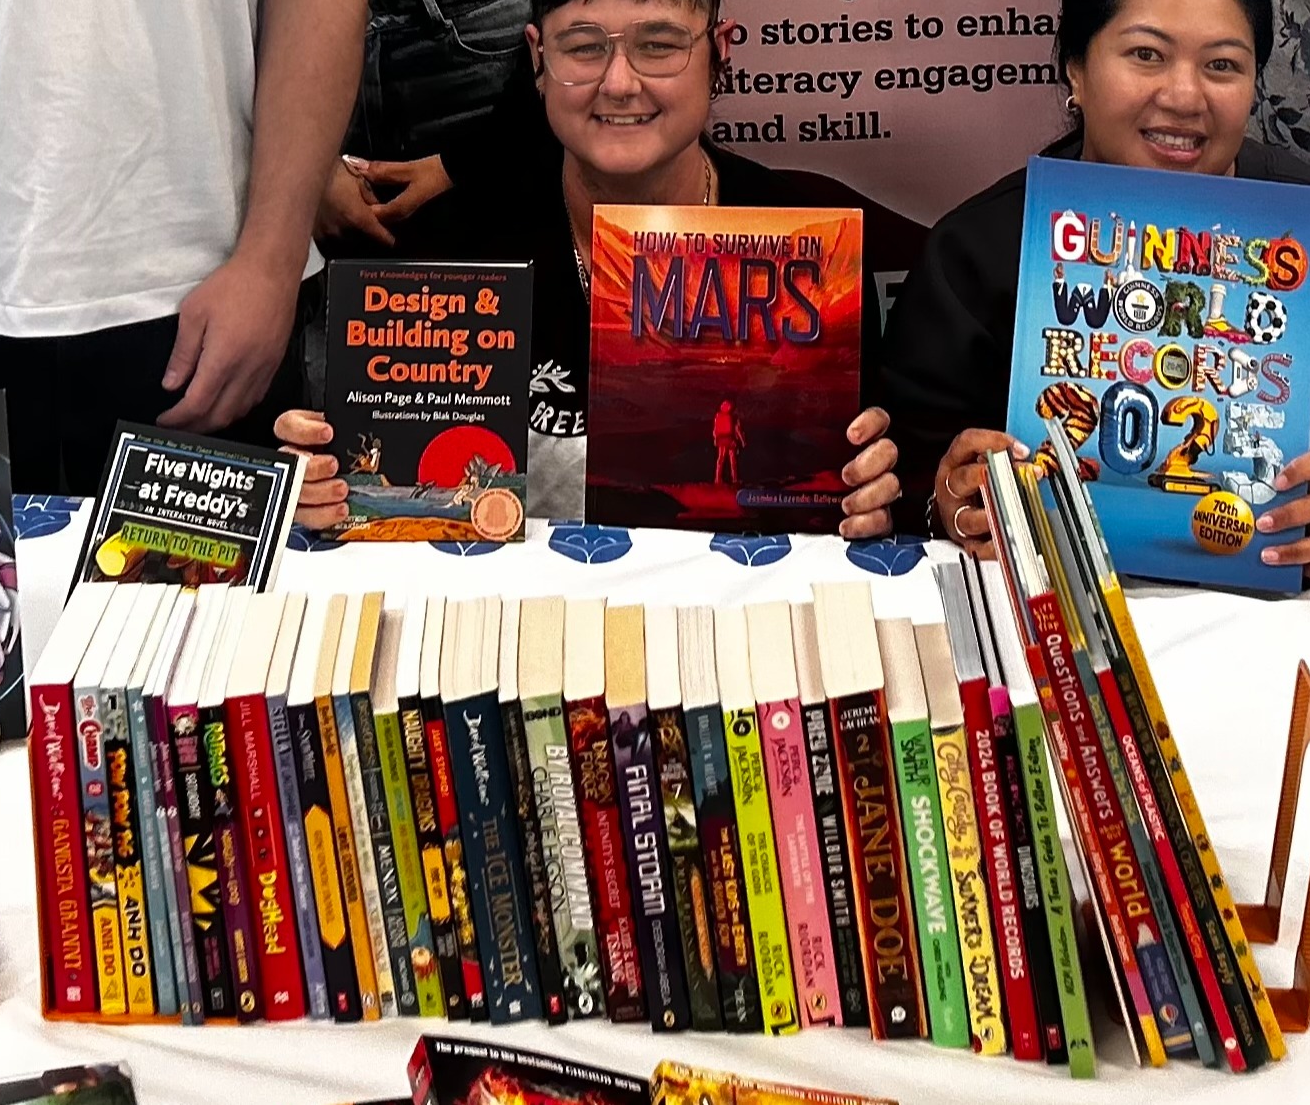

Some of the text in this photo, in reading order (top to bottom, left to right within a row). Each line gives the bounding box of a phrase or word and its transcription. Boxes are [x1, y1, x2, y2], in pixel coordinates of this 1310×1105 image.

[760, 8, 1062, 46] stories to enha
[723, 63, 863, 98] iteracy
[711, 111, 892, 144] and skill.
[633, 231, 823, 258] HOW TO SURVIVE ON
[1051, 208, 1310, 292] GUINNESS
[364, 285, 501, 322] Design &
[631, 255, 822, 343] MARS
[1051, 268, 1289, 345] WORLD
[346, 319, 516, 357] Building on
[366, 355, 494, 392] Country
[1040, 327, 1294, 406] RECORDS
[346, 391, 512, 407] Alison Page & Paul Memmott
[1032, 381, 1286, 505] 2025
[144, 452, 256, 492] Five Nights
[138, 482, 250, 520] at Freddy's
[1213, 499, 1239, 518] 70th
[120, 524, 241, 564] RETURN TO THE PIT
[1199, 525, 1244, 548] EDITION
[1045, 632, 1085, 723] Questions
[1080, 745, 1115, 821] Answers
[975, 729, 995, 769] 2024
[983, 771, 1005, 818] BOOK
[1121, 734, 1147, 783] OCEANS
[1139, 793, 1166, 841] PLASTIC
[624, 764, 667, 917] FINAL STORM
[989, 819, 1007, 841] OF
[853, 774, 908, 985] JANE DOE
[911, 795, 947, 936] SHOCKWAVE
[993, 842, 1017, 902] WORLD
[1109, 841, 1152, 919] World
[51, 818, 83, 972] GANGSTA GRANNY
[124, 898, 142, 941] ANH
[127, 945, 148, 979] DO
[1001, 903, 1026, 980] RECORDS
